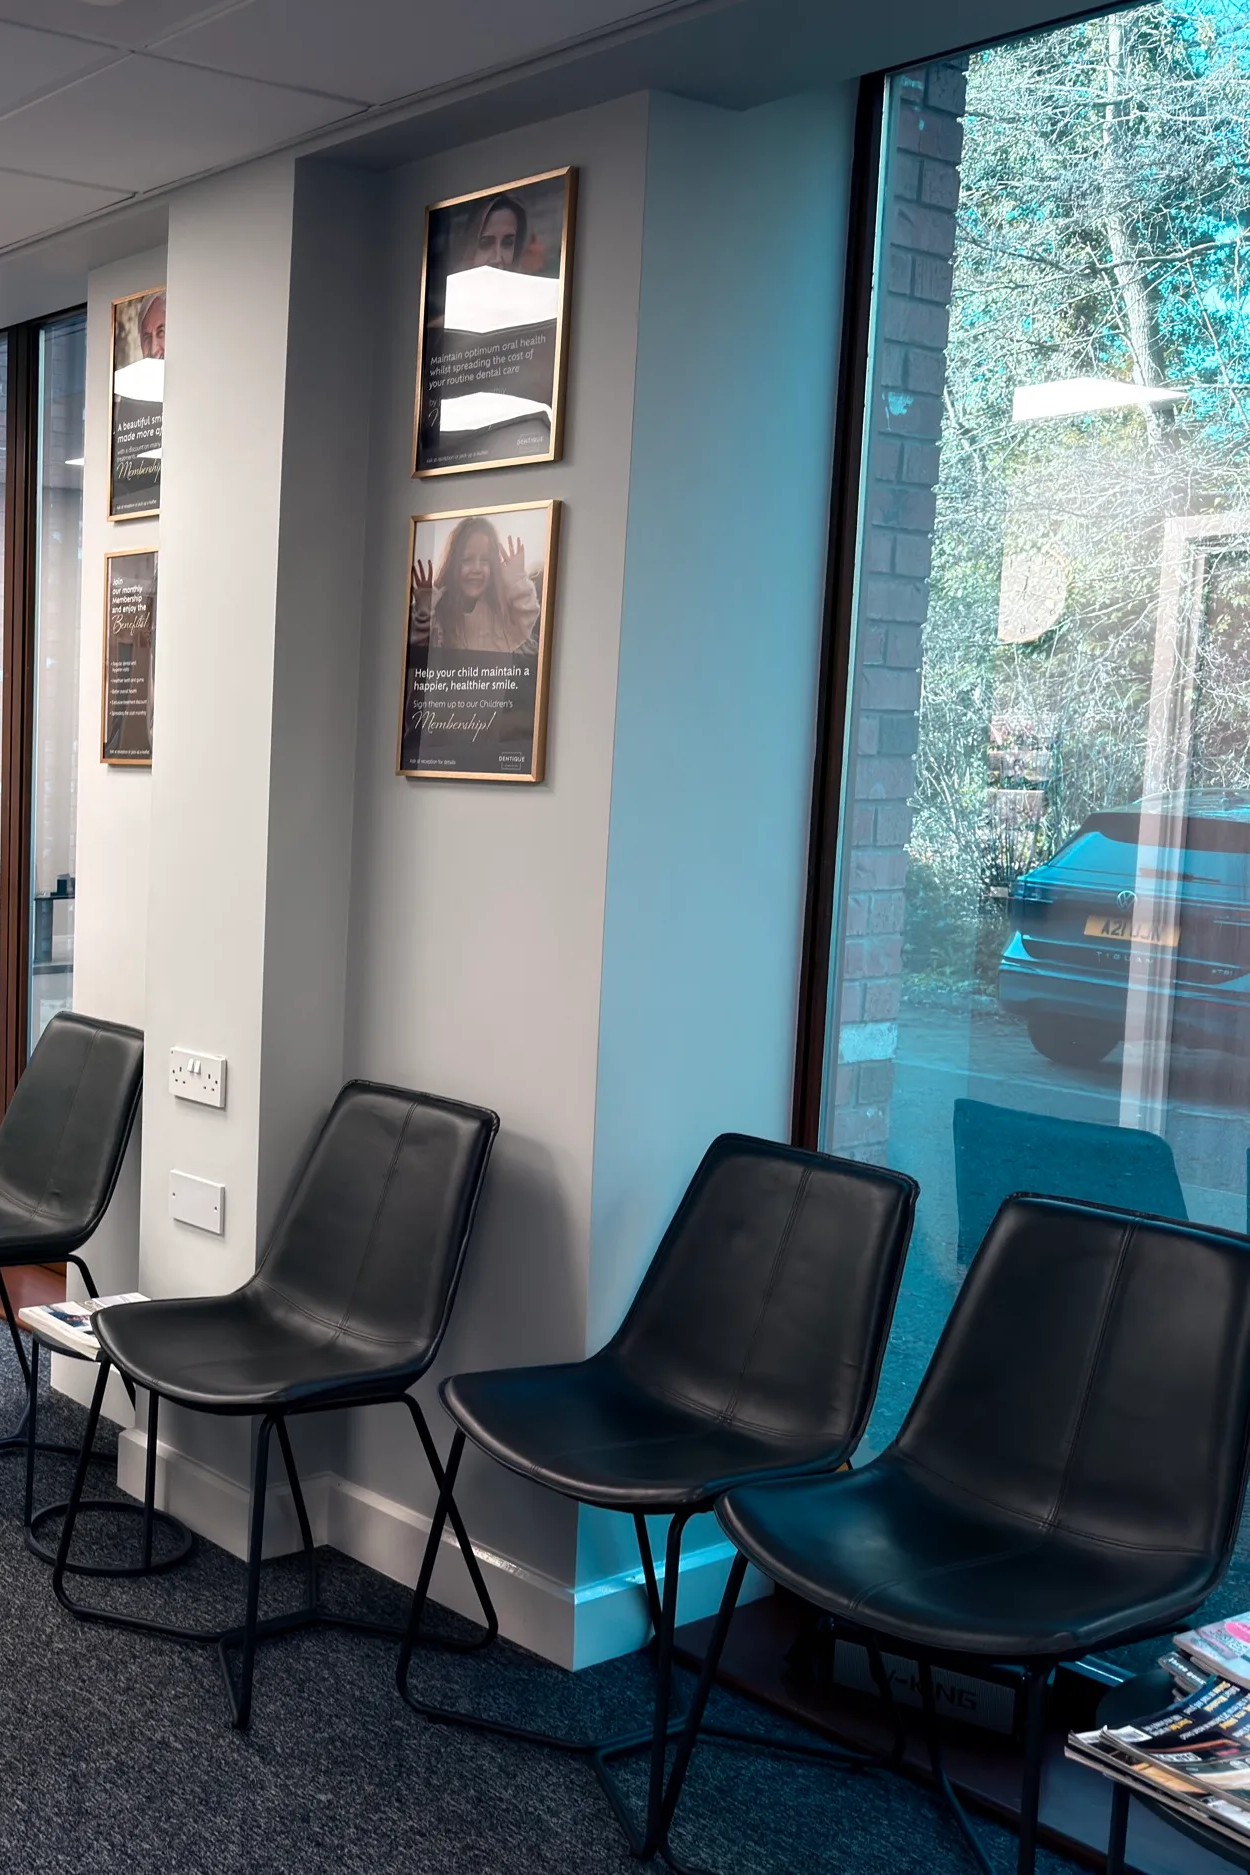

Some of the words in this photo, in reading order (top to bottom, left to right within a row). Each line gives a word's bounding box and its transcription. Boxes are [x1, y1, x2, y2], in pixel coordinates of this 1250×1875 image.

[430, 352, 463, 366] Maintain
[464, 345, 500, 359] optimum
[502, 339, 518, 351] oral
[520, 334, 546, 348] health
[430, 365, 451, 376] whilst
[452, 358, 490, 374] spreading
[492, 355, 506, 365] the
[507, 352, 523, 362] cost
[525, 348, 535, 360] of
[428, 378, 446, 391] your
[446, 373, 474, 386] routine
[476, 367, 501, 380] dental
[502, 365, 520, 375] care
[118, 423, 122, 432] A
[122, 416, 150, 430] beautiful
[118, 431, 135, 443] made
[136, 428, 154, 439] more
[122, 585, 143, 594] monthly
[112, 595, 142, 604] Membership
[112, 605, 121, 613] and
[122, 604, 136, 614] enjoy
[414, 668, 434, 680] Help
[436, 669, 456, 679] your
[458, 667, 478, 677] child
[481, 666, 521, 676] maintain
[524, 668, 530, 676] a
[414, 680, 448, 692] happier,
[450, 680, 490, 690] healthier
[492, 679, 518, 690] smile.
[413, 700, 427, 710] Sign
[428, 700, 445, 708] them
[447, 701, 456, 710] up
[480, 700, 513, 708] Children's
[412, 710, 497, 742] Membership!
